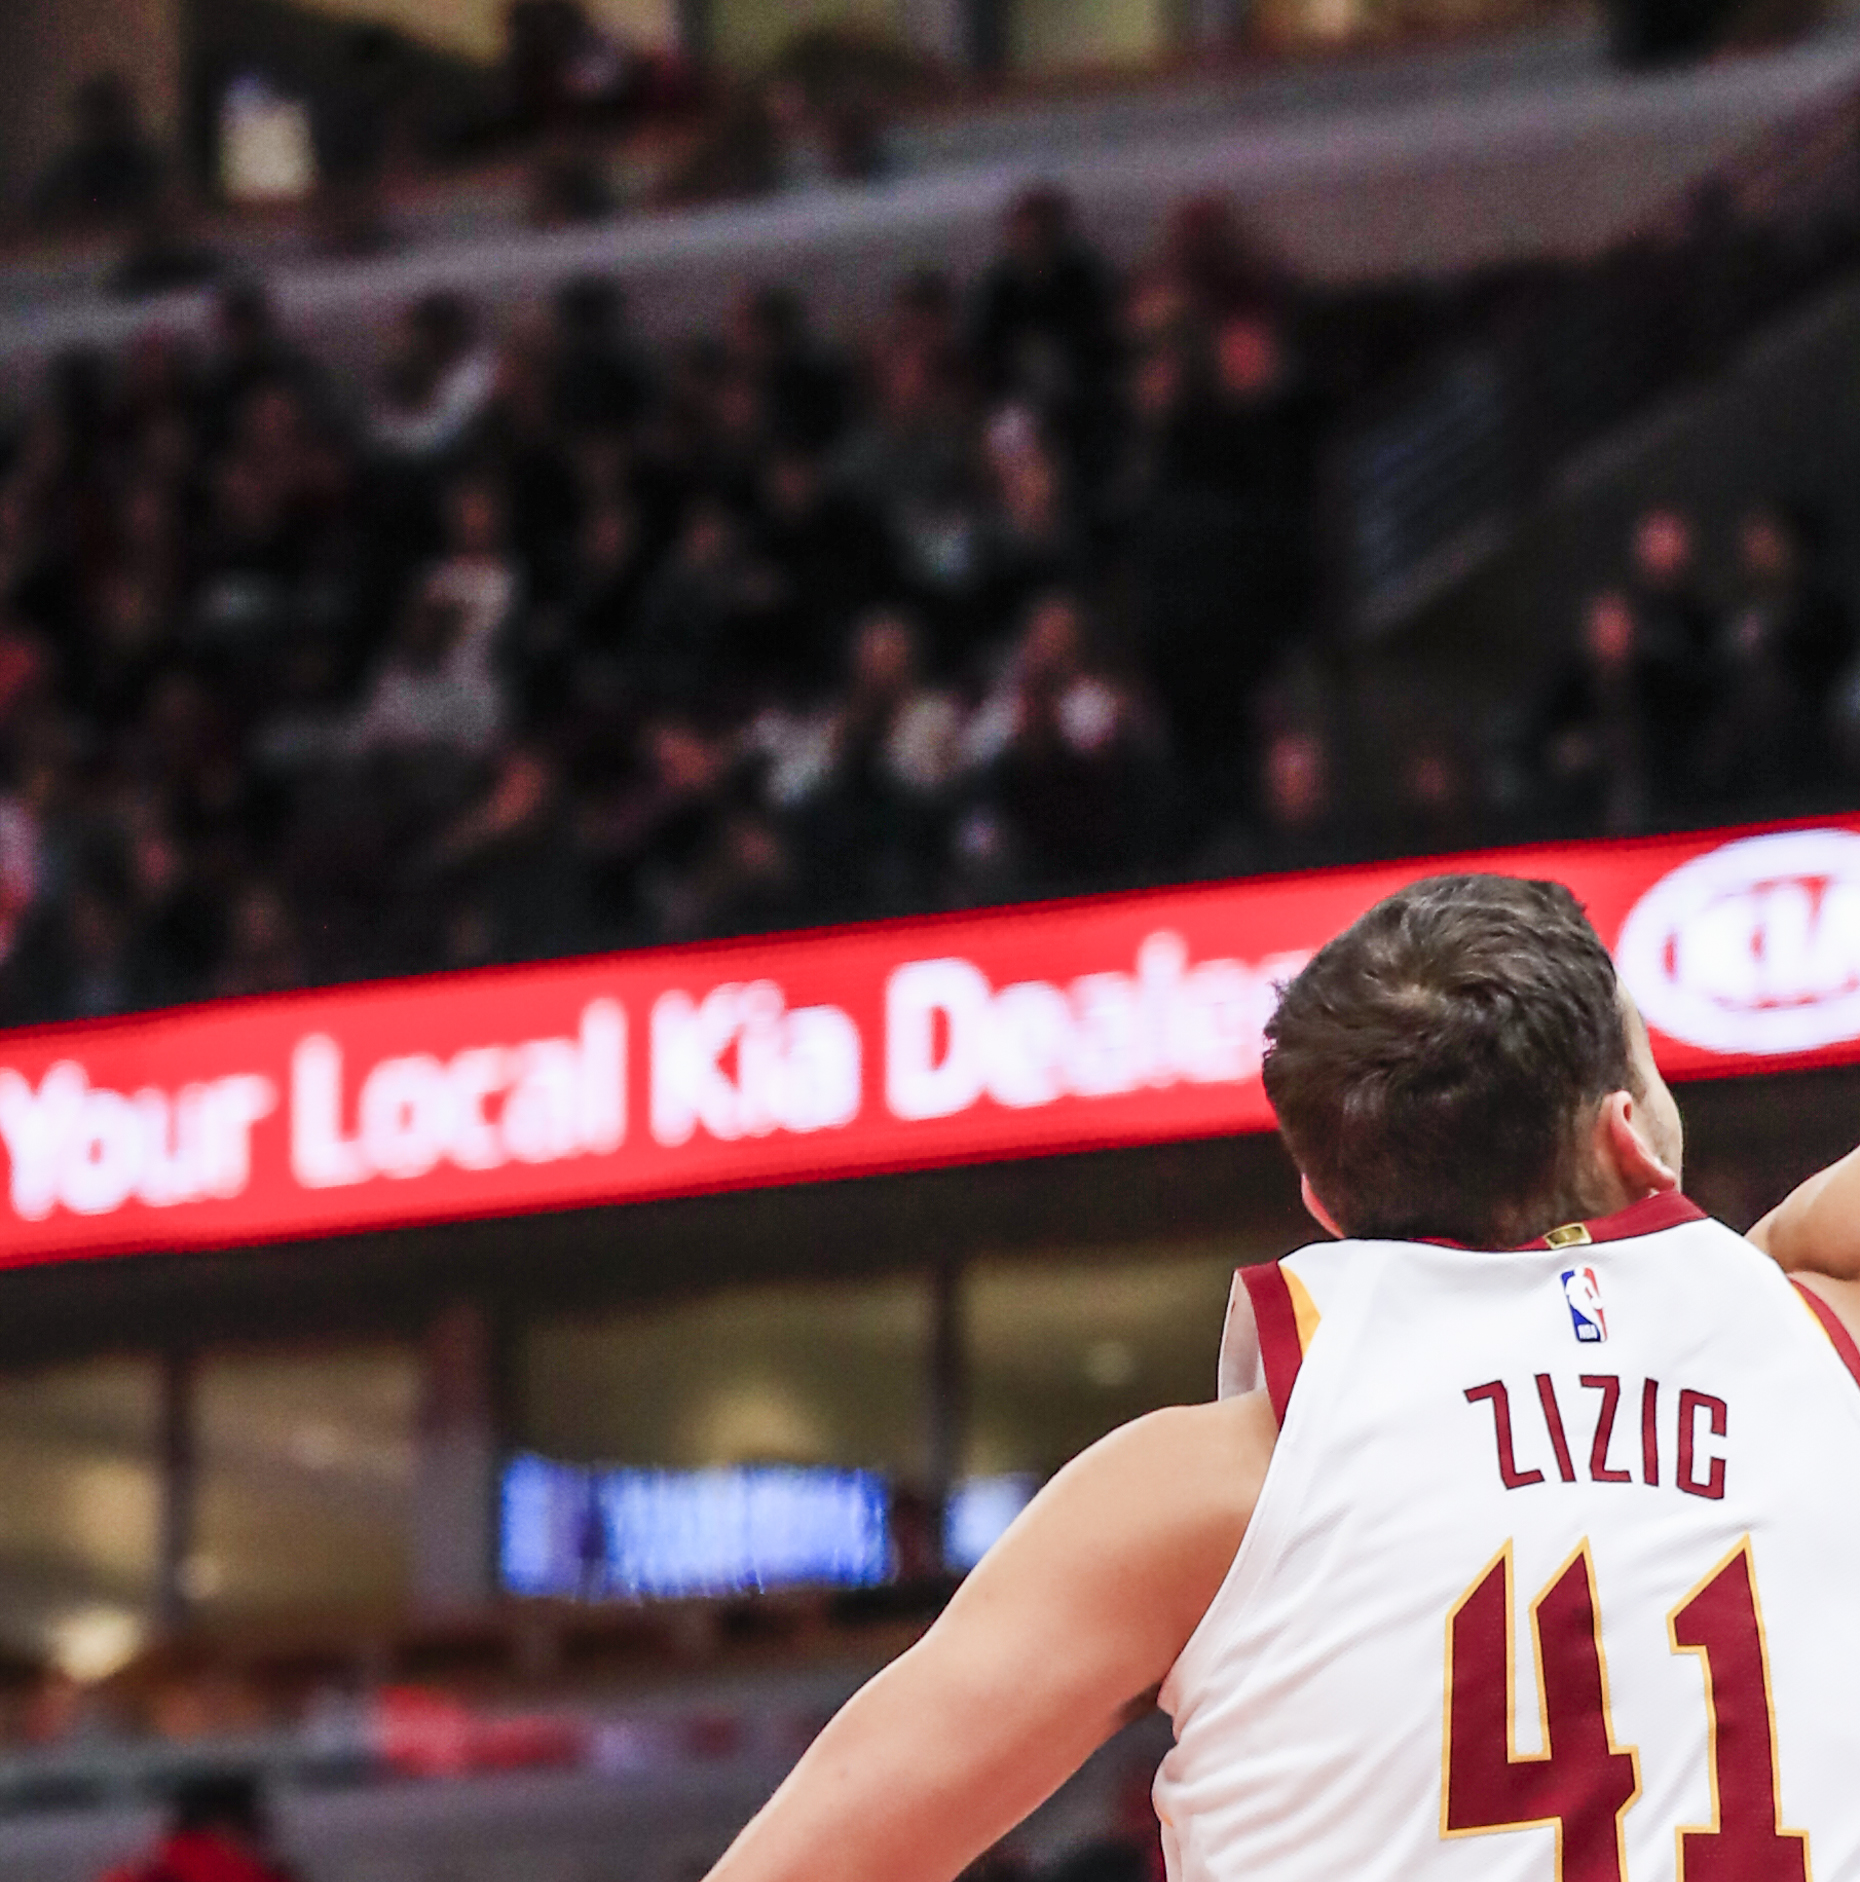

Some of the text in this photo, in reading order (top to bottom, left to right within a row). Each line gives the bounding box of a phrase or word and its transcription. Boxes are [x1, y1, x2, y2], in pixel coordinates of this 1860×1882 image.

[0, 1060, 276, 1221] Your
[291, 1033, 626, 1188] Local
[650, 977, 861, 1148] Kia
[1463, 1373, 1727, 1500] ZIZIC
